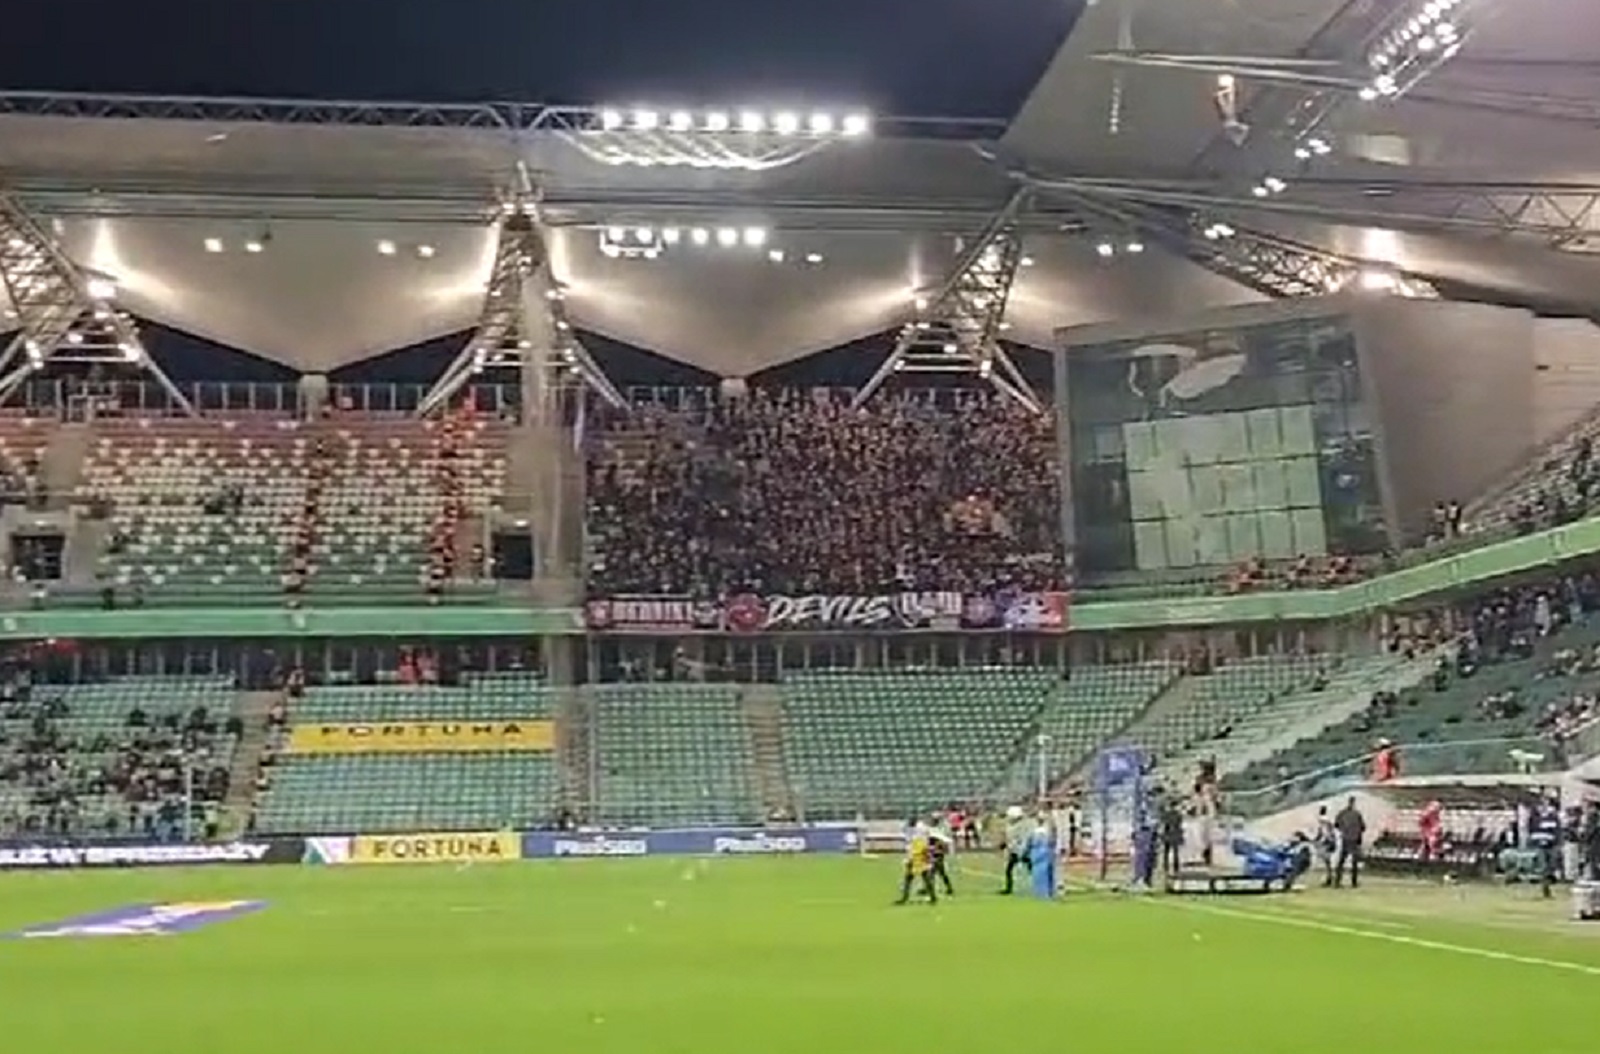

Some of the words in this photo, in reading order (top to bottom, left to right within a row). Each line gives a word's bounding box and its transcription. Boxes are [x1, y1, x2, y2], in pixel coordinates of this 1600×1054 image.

[764, 594, 890, 627] DEVILS
[321, 723, 522, 737] FORTUNA
[373, 839, 501, 858] FORTUNA
